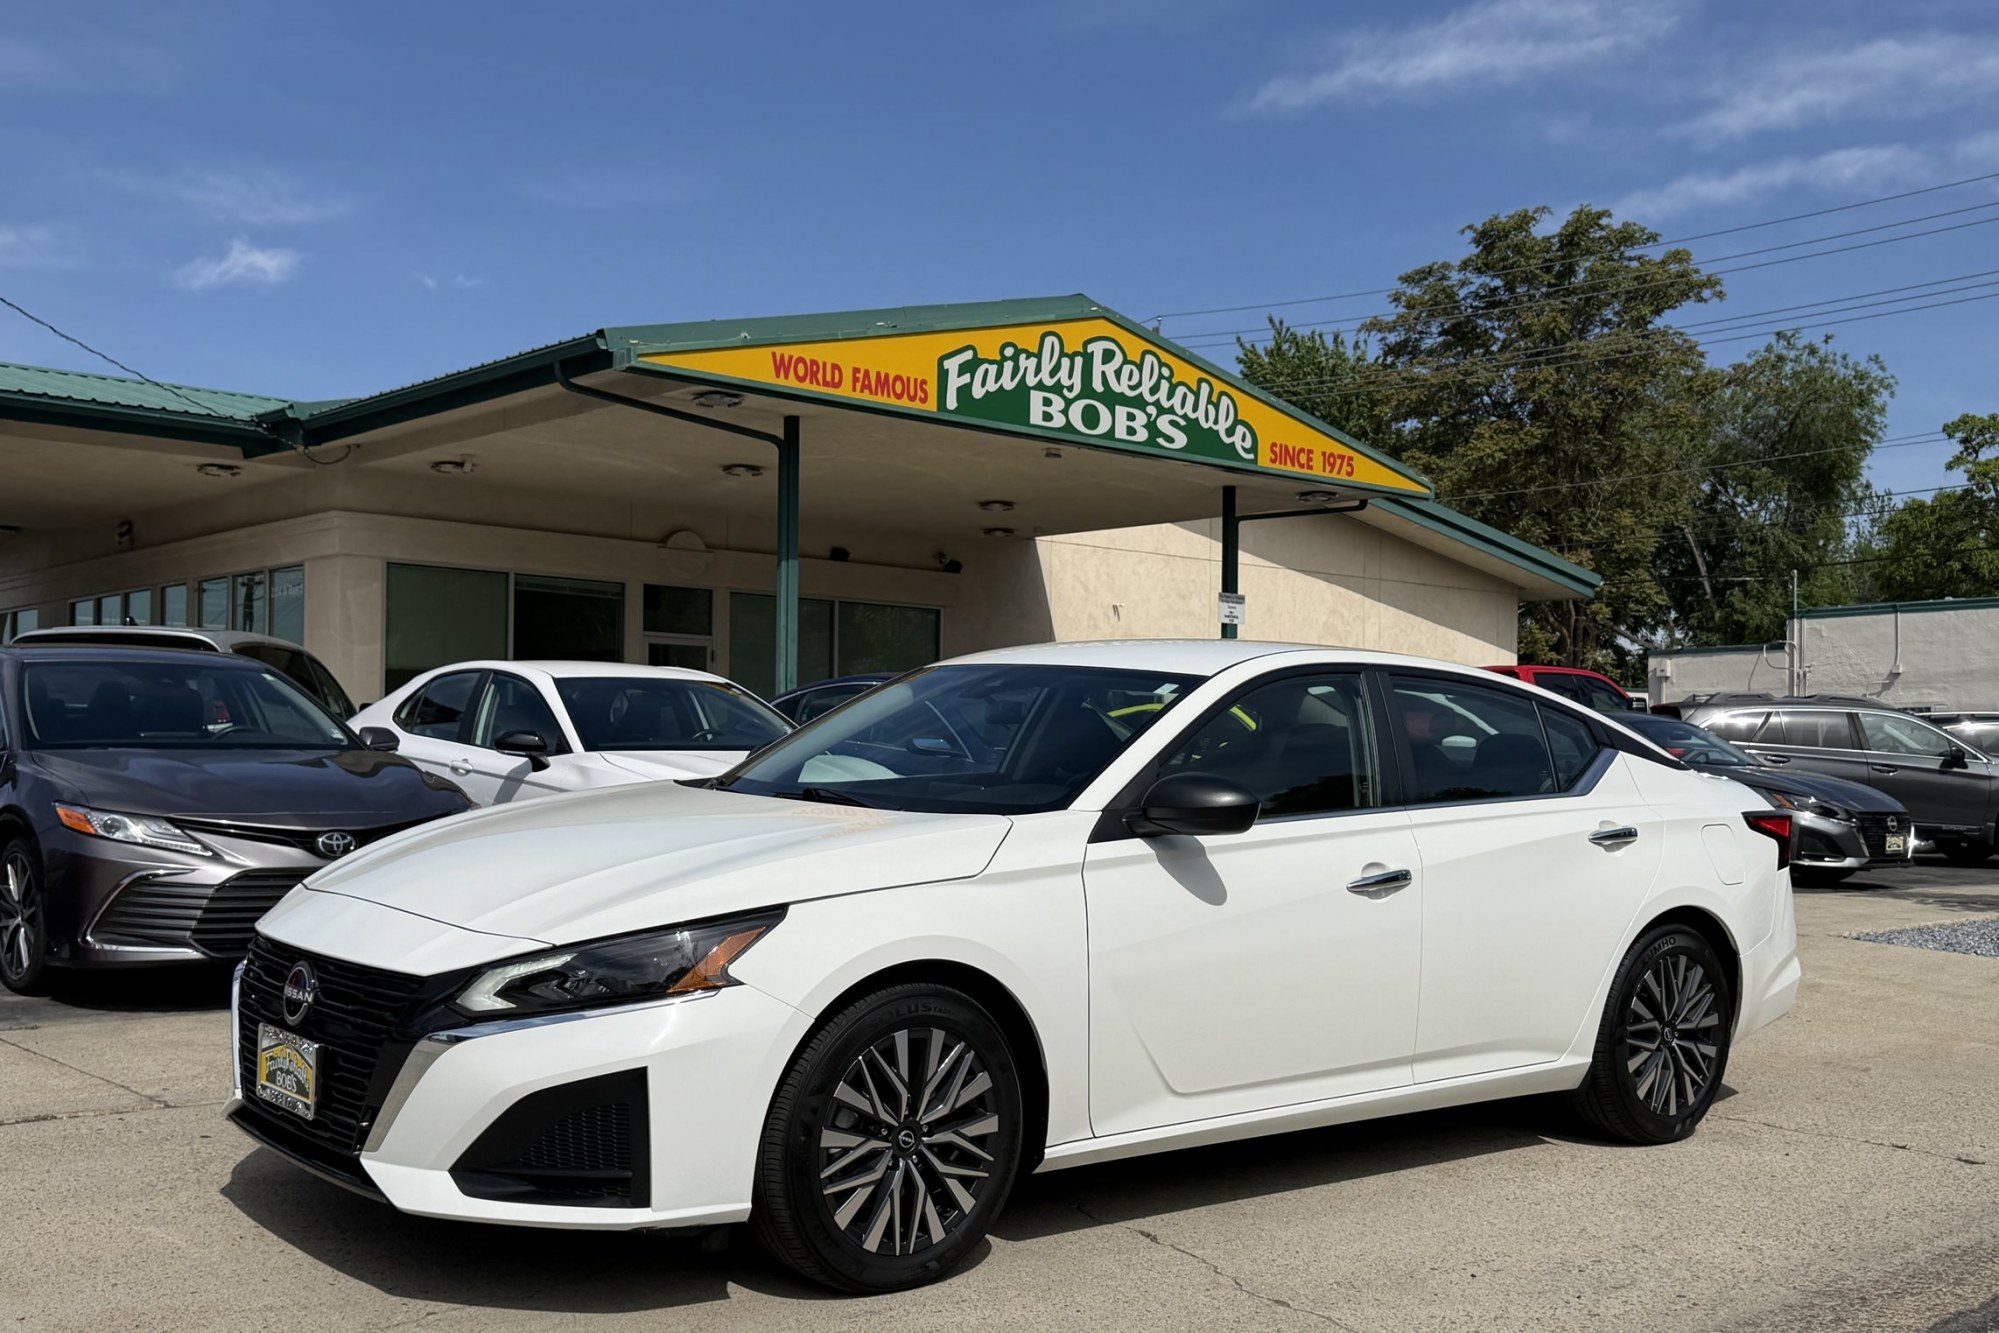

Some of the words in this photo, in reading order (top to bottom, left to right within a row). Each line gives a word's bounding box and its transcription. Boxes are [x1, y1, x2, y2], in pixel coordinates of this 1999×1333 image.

[771, 351, 843, 389] WORLD
[852, 366, 929, 404] FAMOUS
[943, 335, 1083, 411] Fairly
[1087, 340, 1255, 460] Reliable
[1029, 389, 1188, 450] BOB'S
[1269, 441, 1314, 470] SINCE
[1321, 450, 1355, 477] 1975
